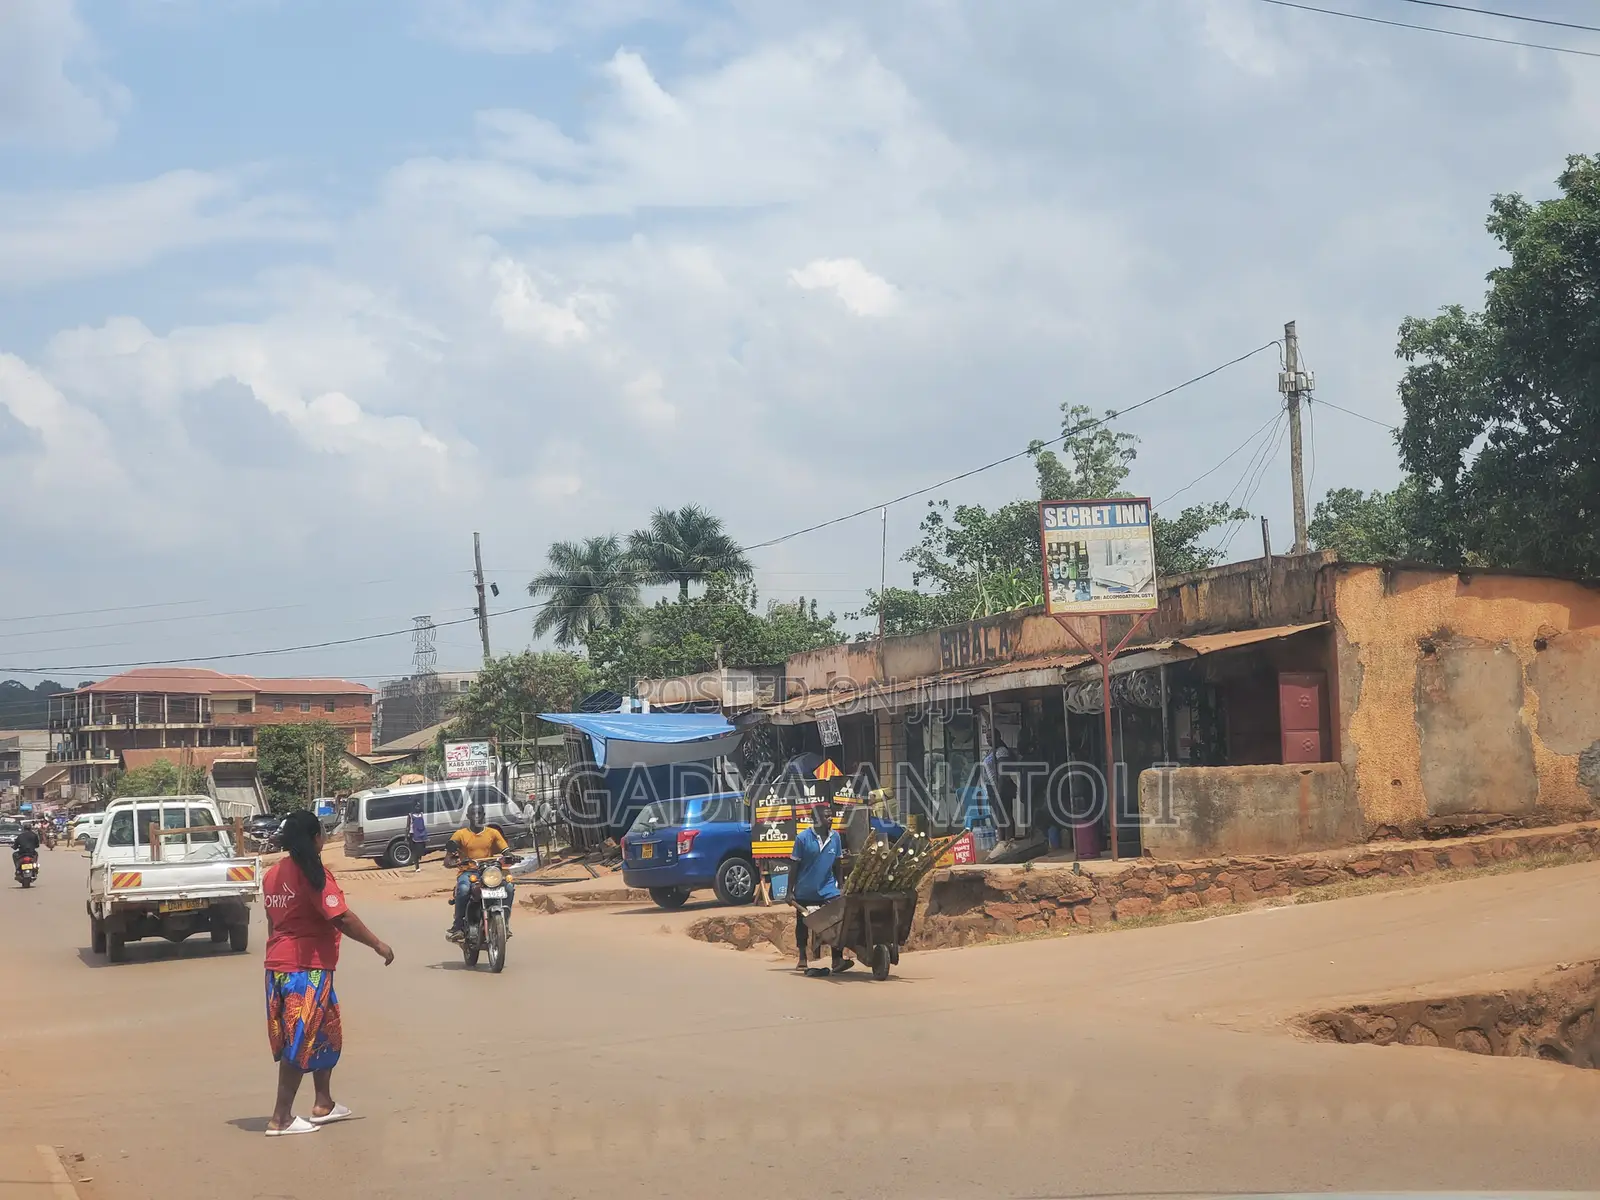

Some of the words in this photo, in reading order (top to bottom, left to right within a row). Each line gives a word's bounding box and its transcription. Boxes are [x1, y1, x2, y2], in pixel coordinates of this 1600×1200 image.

[1044, 506, 1111, 528] SECRET
[1115, 504, 1147, 524] INN
[758, 797, 788, 807] FUSO
[795, 796, 825, 804] ISUZU
[759, 833, 789, 842] FUSO
[264, 894, 288, 909] ORYX
